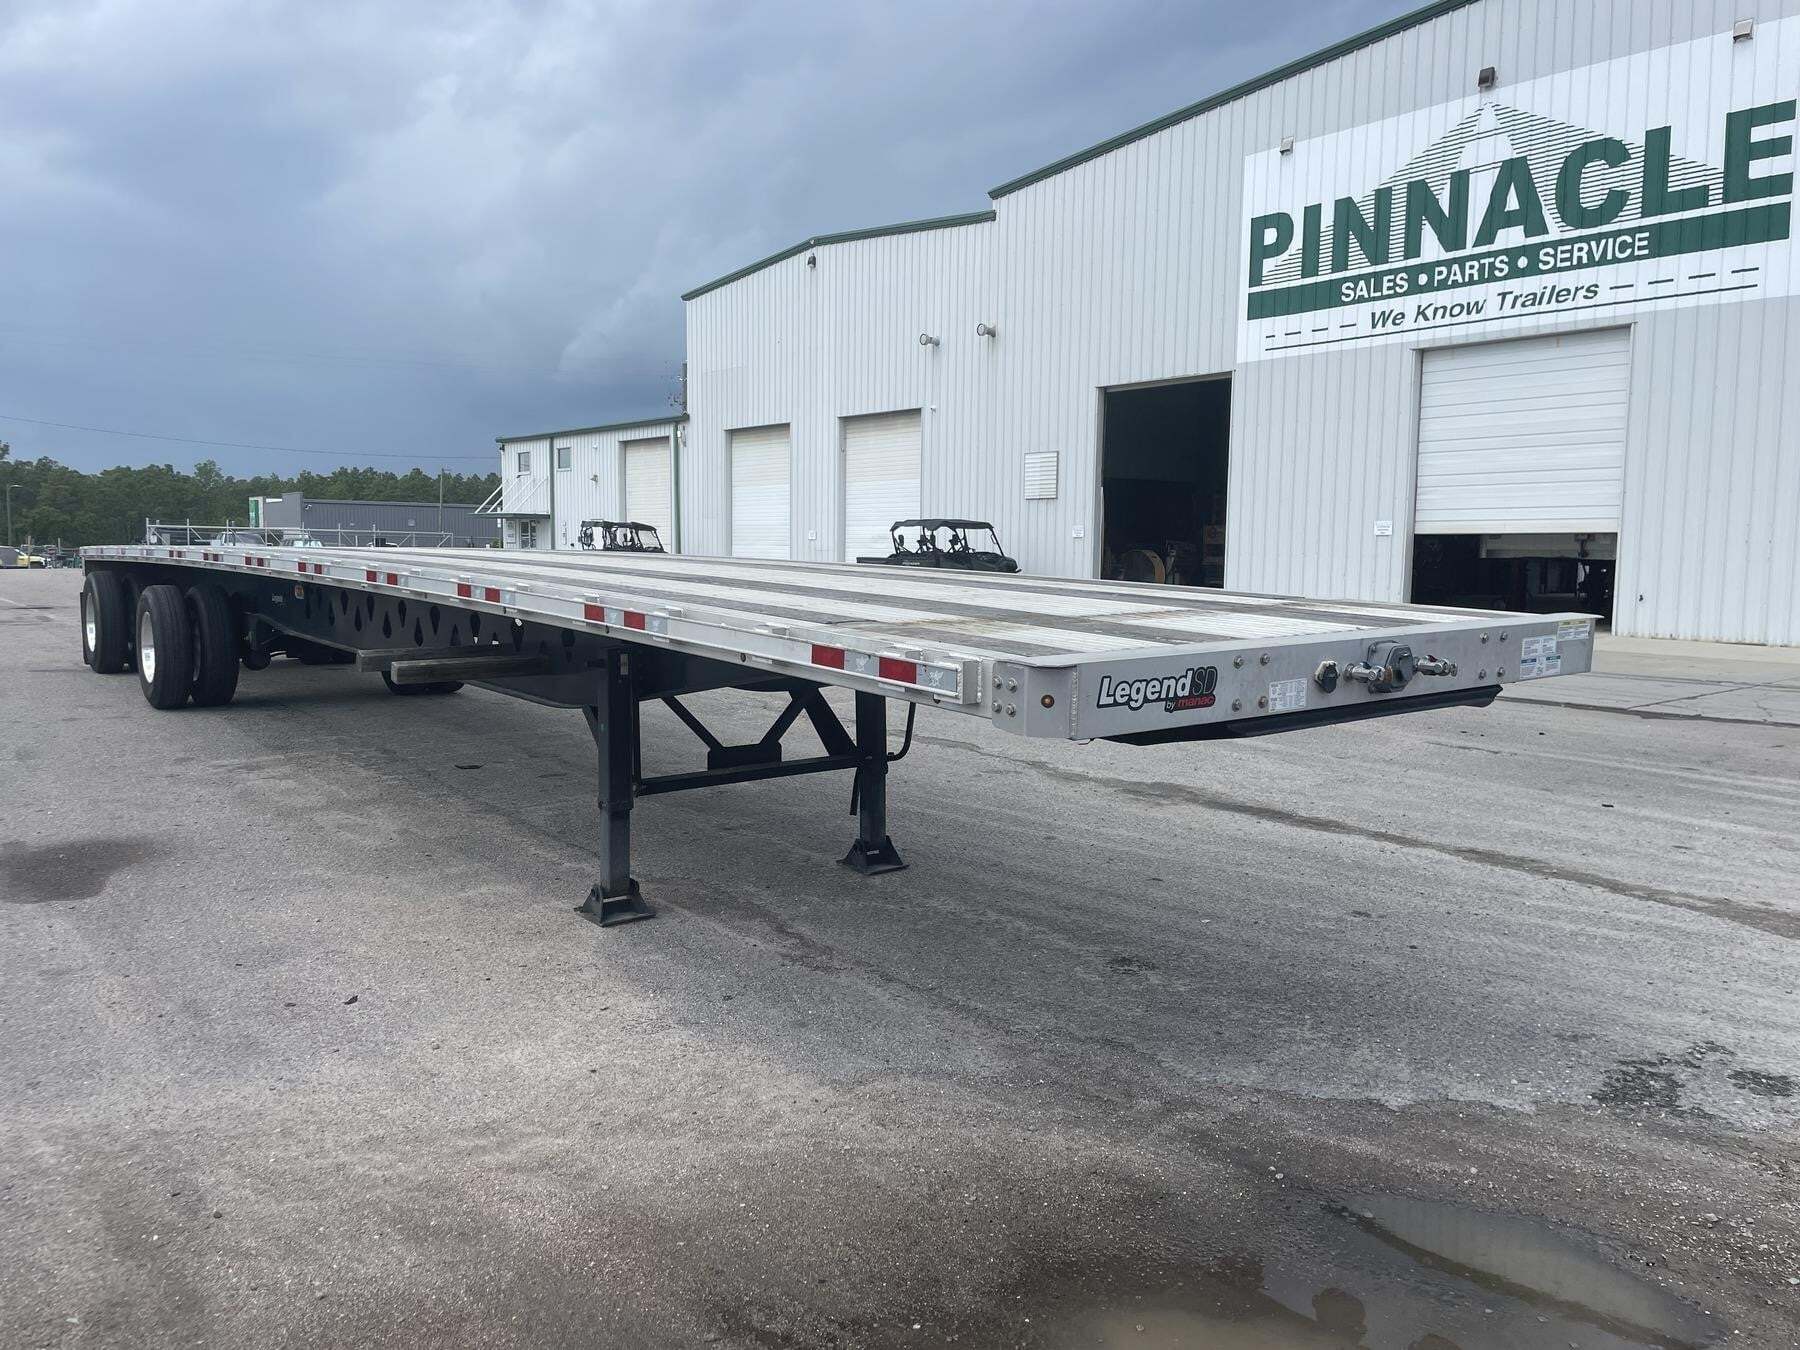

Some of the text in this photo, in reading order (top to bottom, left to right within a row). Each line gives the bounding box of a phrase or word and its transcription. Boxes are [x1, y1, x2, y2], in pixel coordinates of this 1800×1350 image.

[1248, 99, 1797, 288] PINNACLE
[1341, 232, 1650, 302] SALES PARTS SERVICE
[1370, 280, 1600, 330] We Know Trailers
